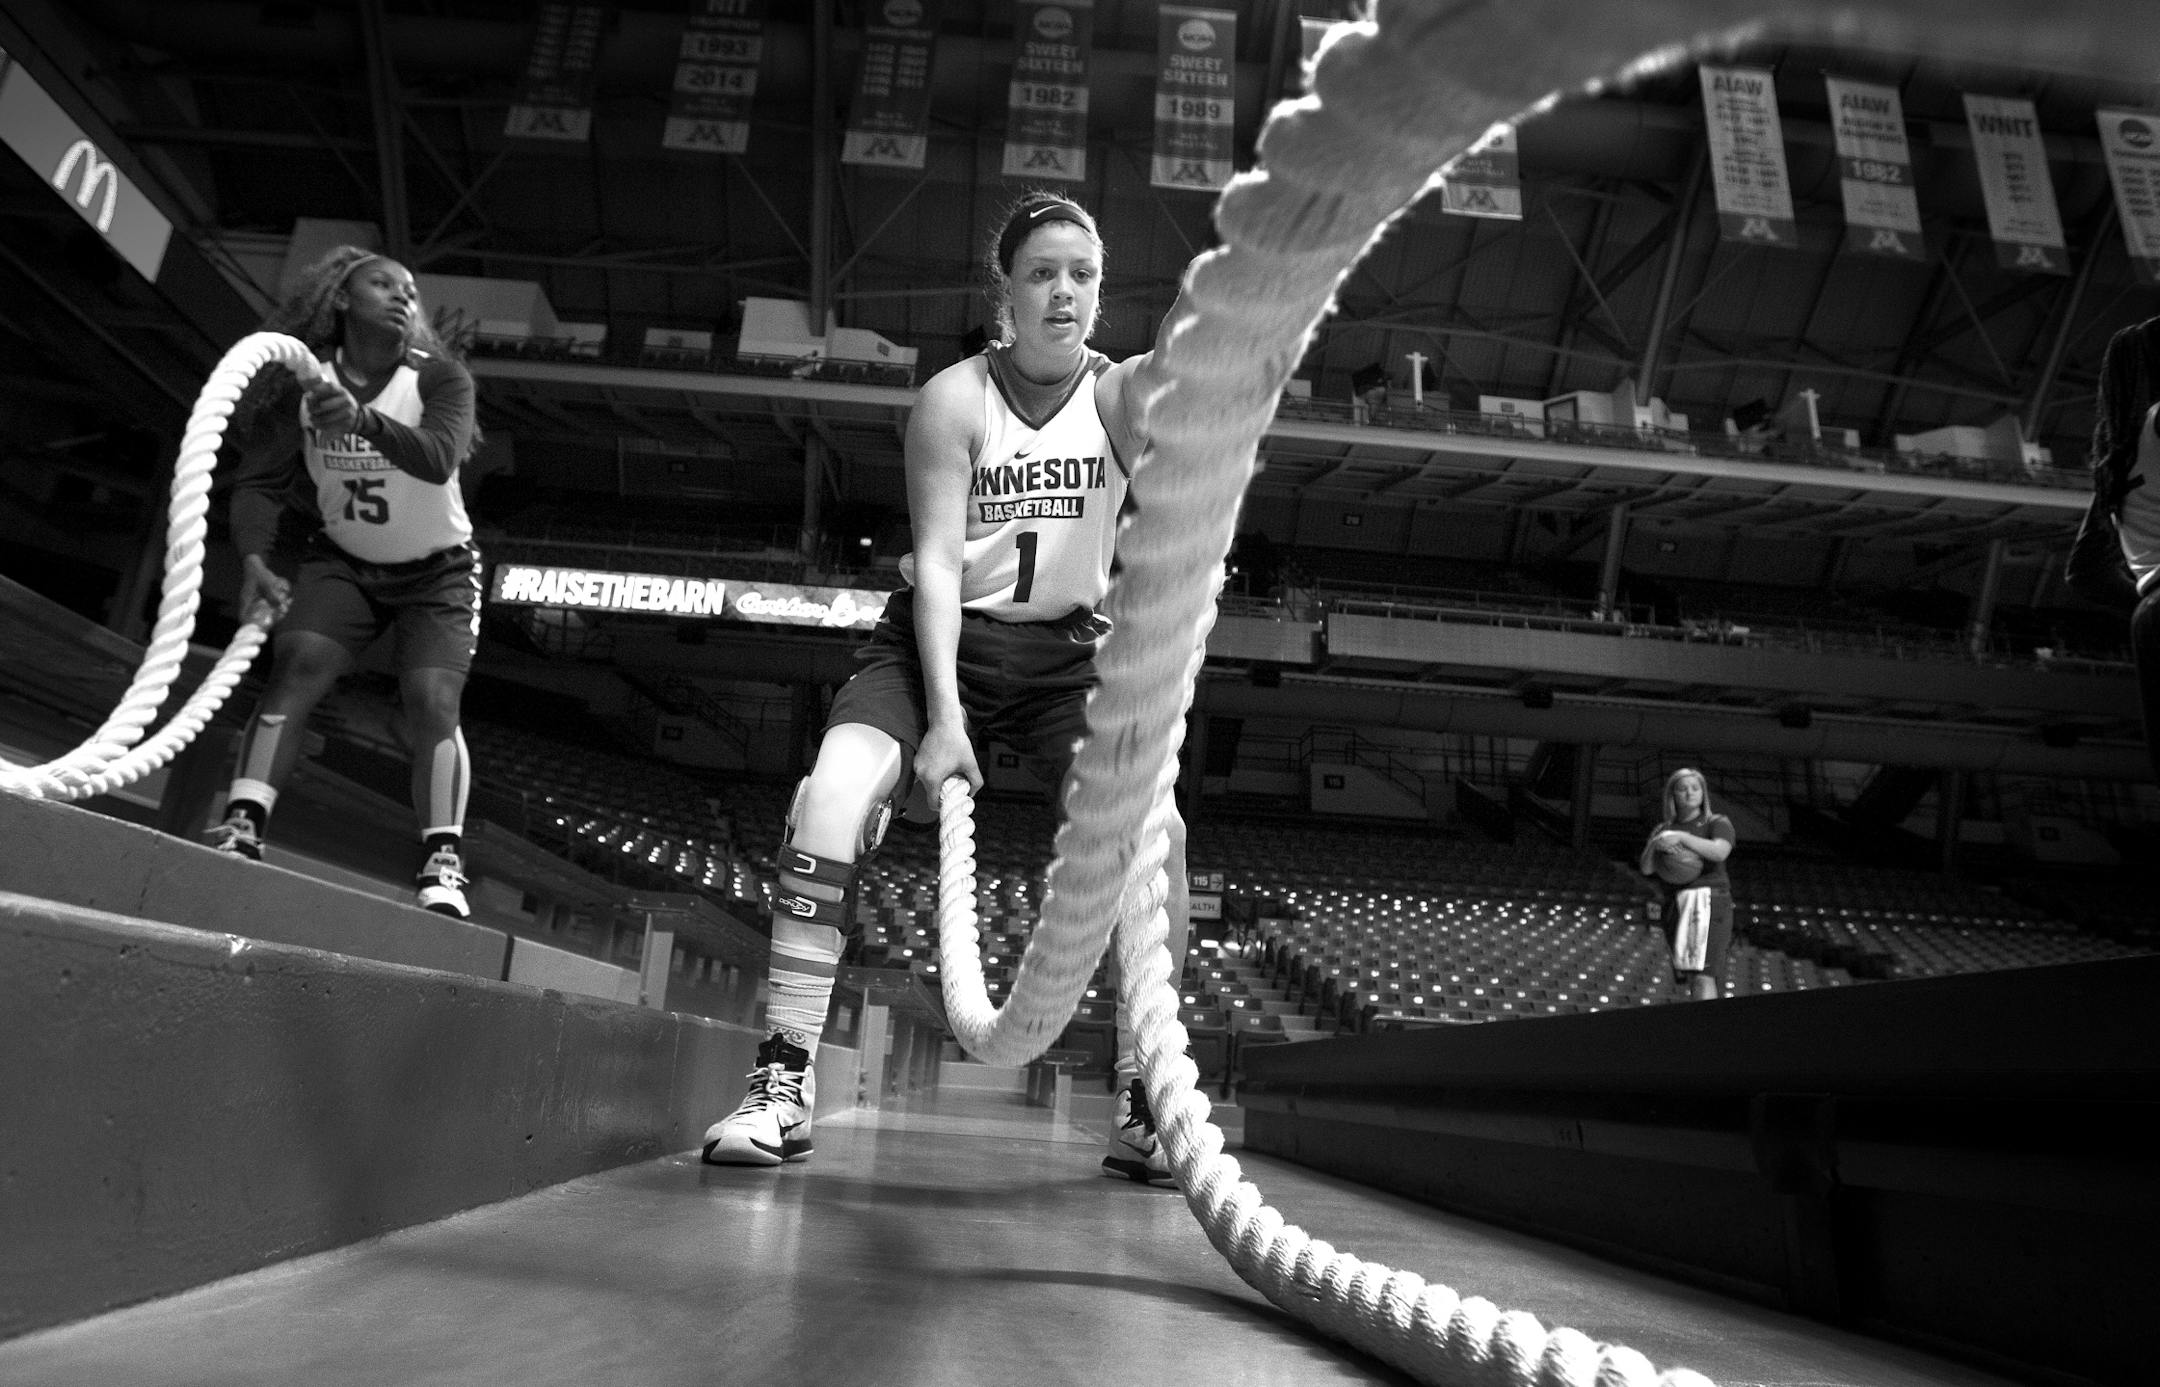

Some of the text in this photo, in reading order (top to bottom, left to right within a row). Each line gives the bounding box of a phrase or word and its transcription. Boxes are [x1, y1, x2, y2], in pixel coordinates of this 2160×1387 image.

[1024, 41, 1080, 60] SWEET
[1016, 55, 1084, 74] SIXTEEN
[1169, 53, 1223, 73] SWEET
[686, 69, 744, 88] 2014
[1162, 67, 1229, 88] SIXTEEN
[1714, 75, 1764, 97] AIAW
[1023, 87, 1076, 107] 1982
[1841, 93, 1890, 116] AIAW
[1168, 99, 1221, 120] 1989
[1973, 113, 2034, 139] WNIT
[970, 457, 1105, 496] INNESOTA
[983, 499, 1080, 521] BASKETBALL
[1012, 531, 1038, 603] 1
[501, 568, 723, 615] #RAISETHEBARN
[1193, 875, 1209, 887] 115
[1190, 902, 1216, 912] ALTH
